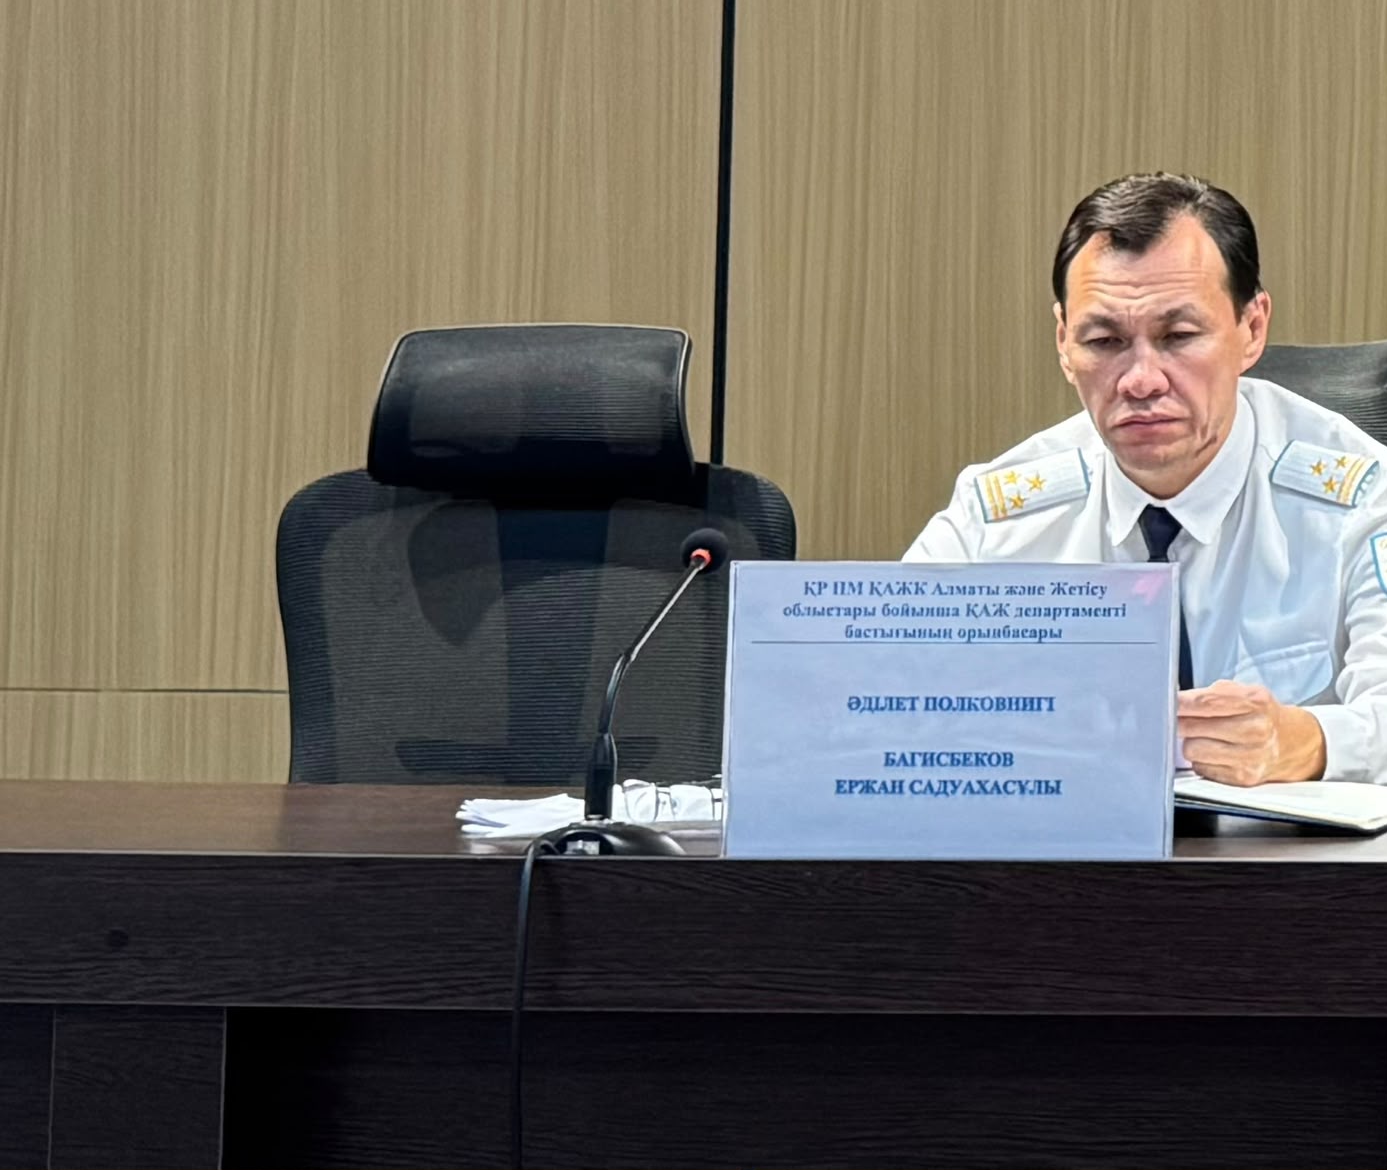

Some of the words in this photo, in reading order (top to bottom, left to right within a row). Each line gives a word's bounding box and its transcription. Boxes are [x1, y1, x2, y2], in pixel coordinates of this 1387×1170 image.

[804, 581, 828, 597] ҚР
[869, 581, 928, 598] ҚАЖК
[931, 581, 1000, 596] Алматы
[1004, 584, 1045, 596] және
[1049, 581, 1108, 600] Жетісу
[783, 603, 876, 620] облыстары
[881, 603, 960, 617] бойынша
[965, 603, 1010, 619] ҚАЖ
[1013, 603, 1127, 621] департаменті
[844, 624, 952, 640] бастығының
[957, 625, 1063, 643] орынбасары
[847, 695, 919, 714] ӘДІЛЕТ
[924, 696, 1056, 712] ПОЛКОВНИГІ
[884, 751, 1015, 767] БАГИСБЕКОВ
[834, 779, 905, 795] ЕРЖАН
[909, 779, 1063, 797] САДУАХАСҰЛЫ
